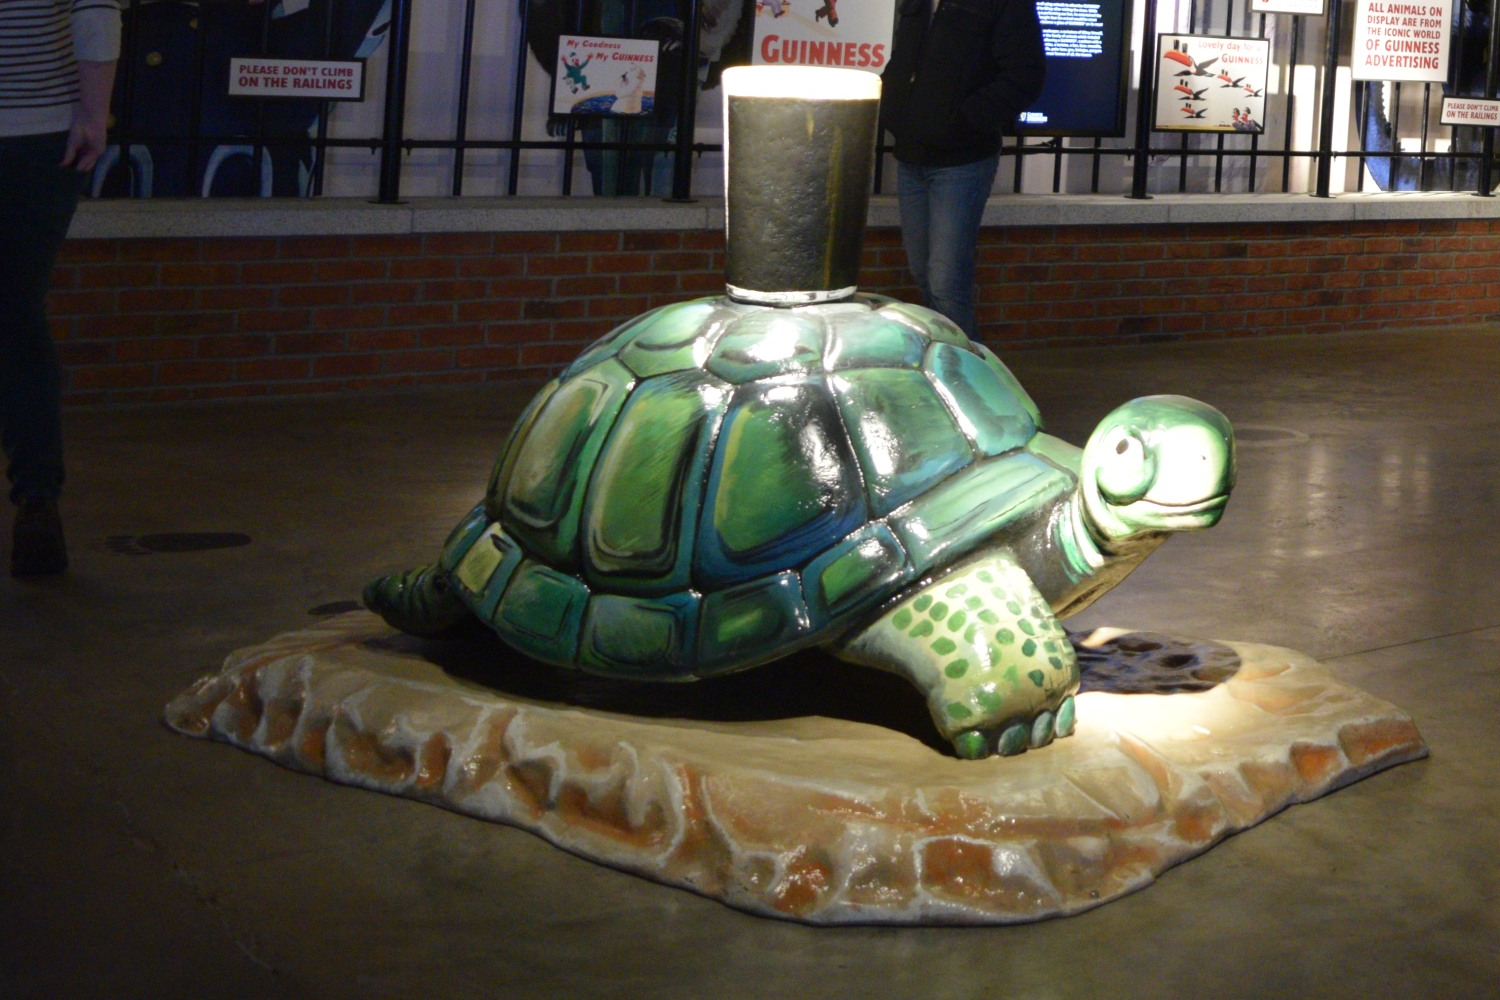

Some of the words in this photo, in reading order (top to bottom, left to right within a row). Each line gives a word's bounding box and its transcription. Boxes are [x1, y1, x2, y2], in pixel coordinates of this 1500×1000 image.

[1368, 2, 1385, 13] ALL
[1387, 3, 1426, 16] ANIMALS
[1429, 6, 1442, 17] ON
[1367, 15, 1400, 26] DISPLAY
[1402, 17, 1417, 27] ARE
[1420, 18, 1442, 28] FROM
[1367, 27, 1381, 36] THE
[1384, 28, 1411, 38] ICONIC
[1413, 29, 1441, 40] WORLD
[567, 39, 579, 48] My
[582, 40, 621, 49] Goodness
[1198, 41, 1224, 51] Lovely
[1227, 41, 1241, 51] day
[1365, 39, 1380, 51] OF
[1385, 39, 1440, 54] GUINNESS
[596, 52, 609, 62] My
[612, 52, 655, 63] GUINNESS
[761, 34, 885, 68] GUINNESS
[1221, 53, 1263, 65] GUINNESS
[1365, 54, 1439, 70] ADVERTISING
[239, 65, 279, 75] PLEASE
[283, 66, 318, 76] DON'T
[321, 67, 353, 77] CLIMB
[238, 76, 259, 88] ON
[263, 77, 288, 89] THE
[293, 78, 353, 90] RAILINGS
[1470, 112, 1498, 120] RAILINGS
